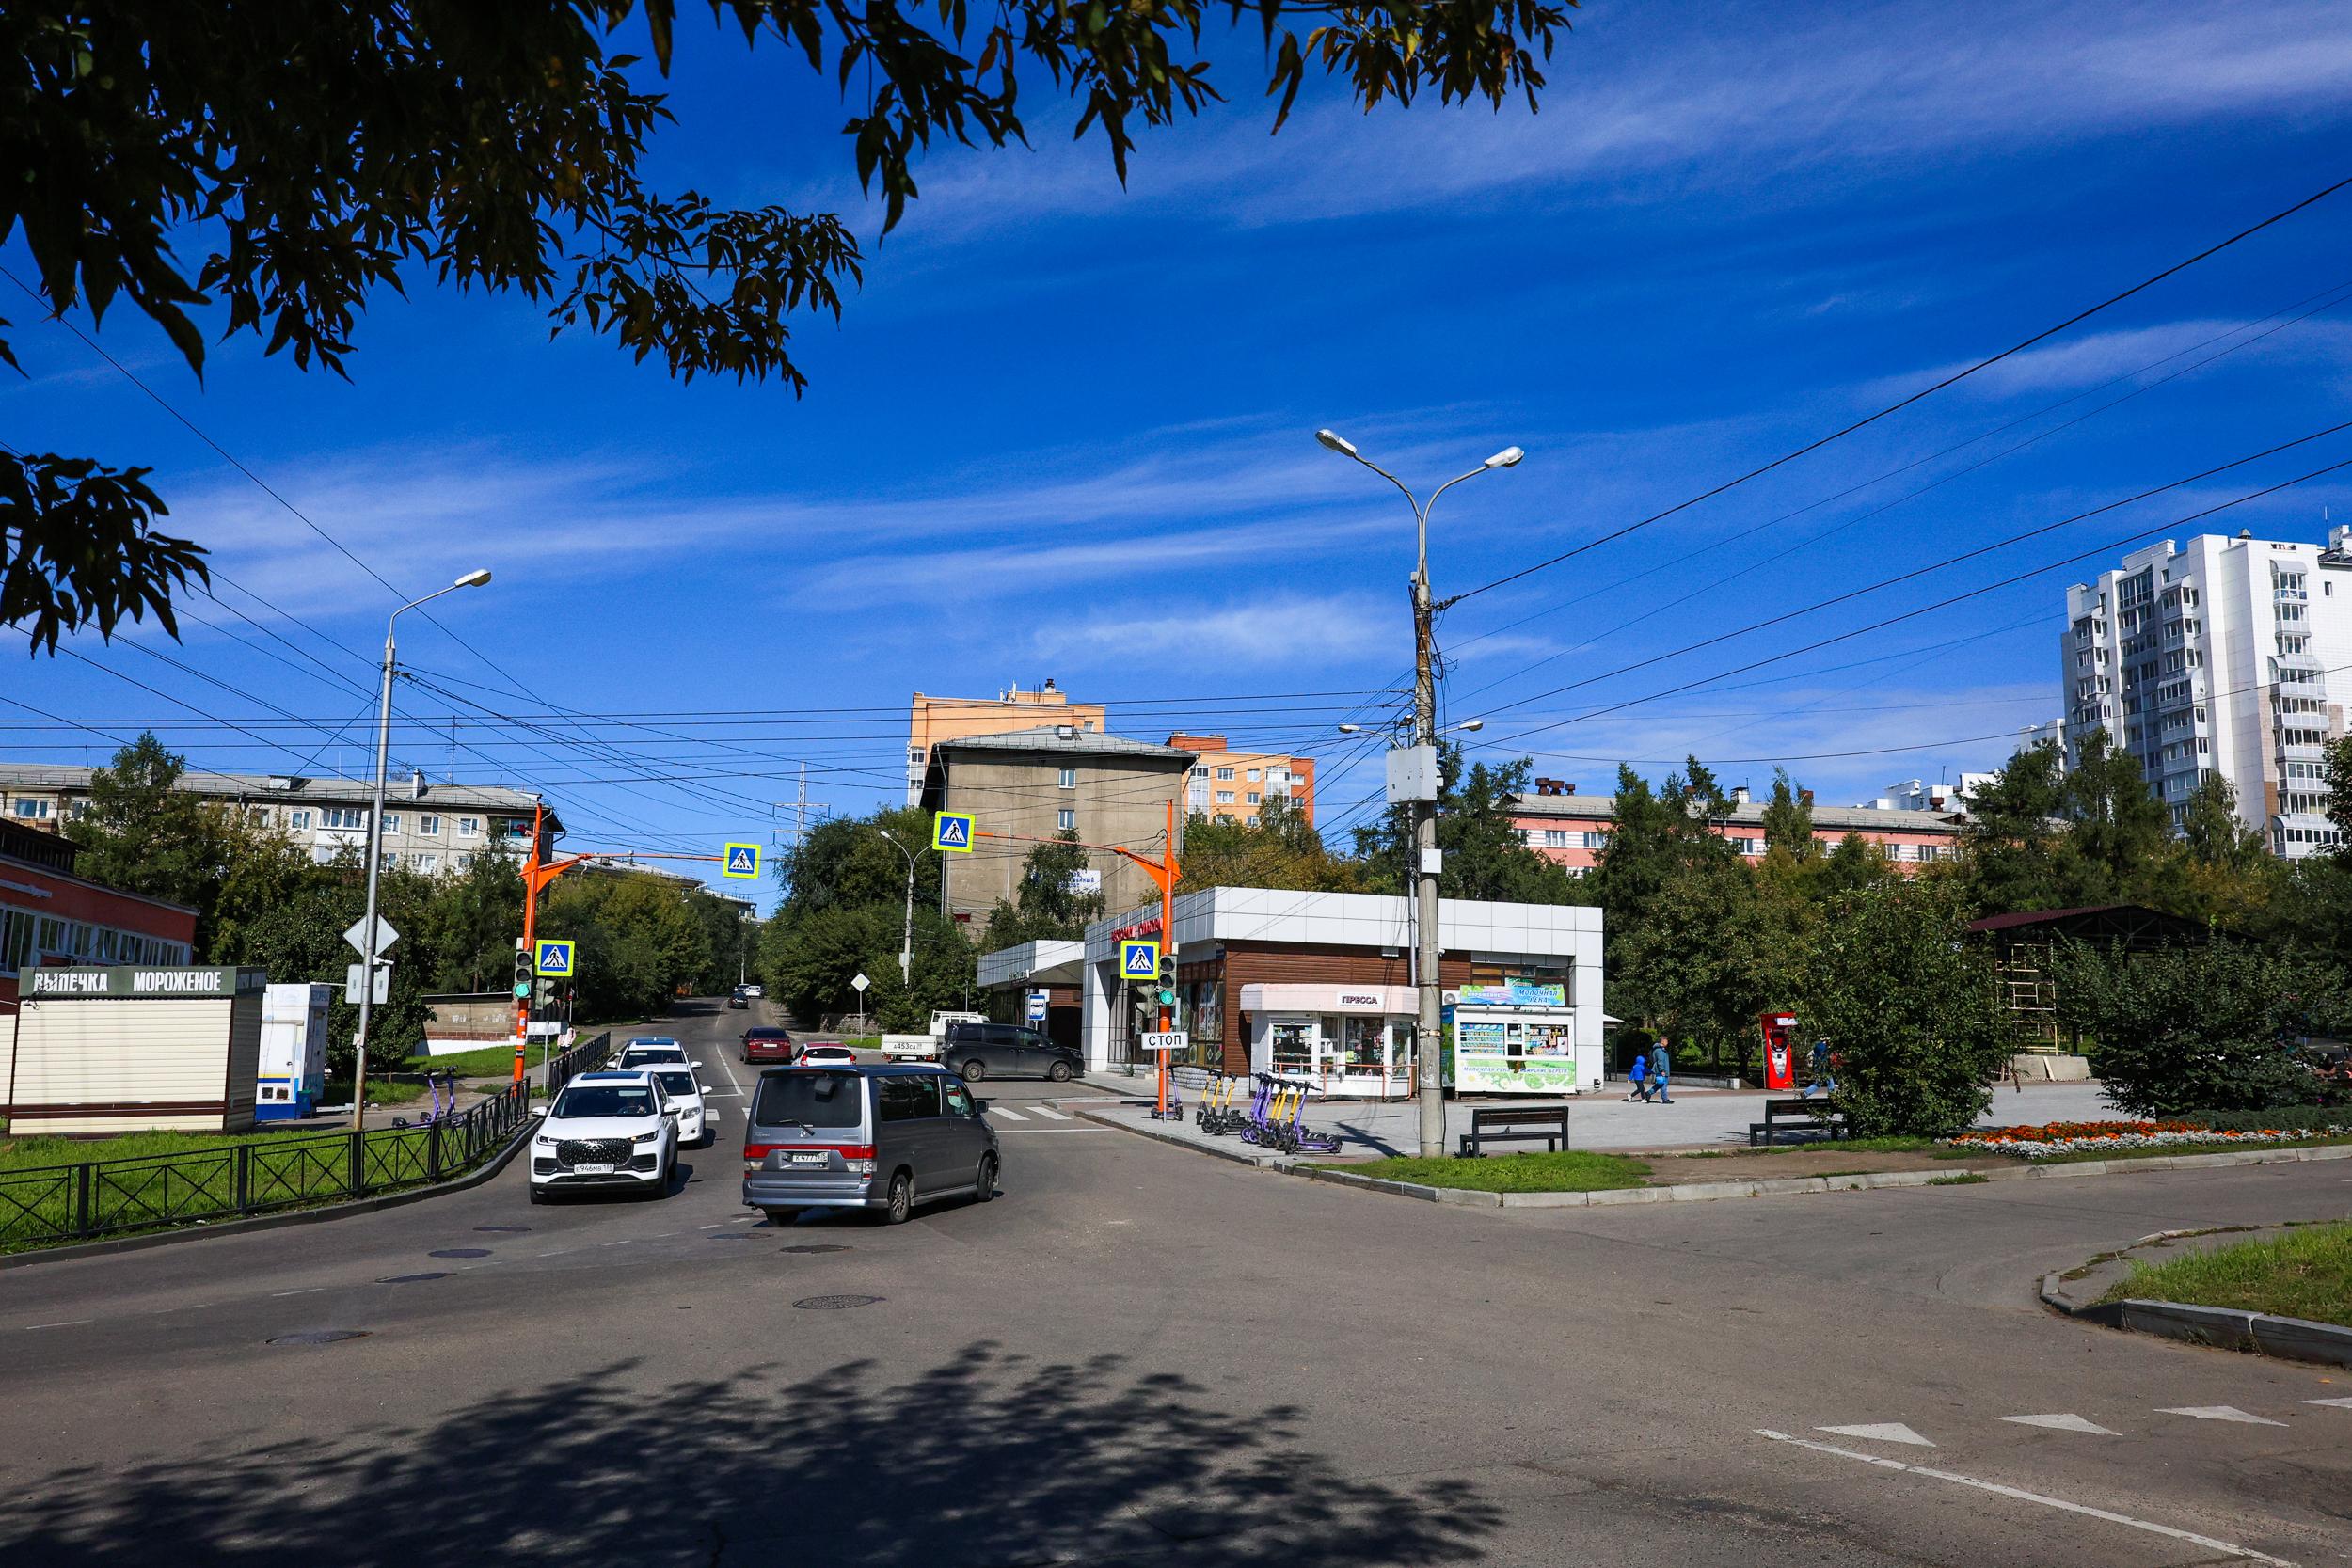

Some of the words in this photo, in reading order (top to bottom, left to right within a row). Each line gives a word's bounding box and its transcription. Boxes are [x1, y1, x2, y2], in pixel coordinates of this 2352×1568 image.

[33, 973, 108, 992] ВЫПЕЧКА
[133, 972, 222, 992] МОРОЖЕНОЕ
[1341, 995, 1378, 1005] ПРЕССА
[1148, 1035, 1182, 1046] СТОП
